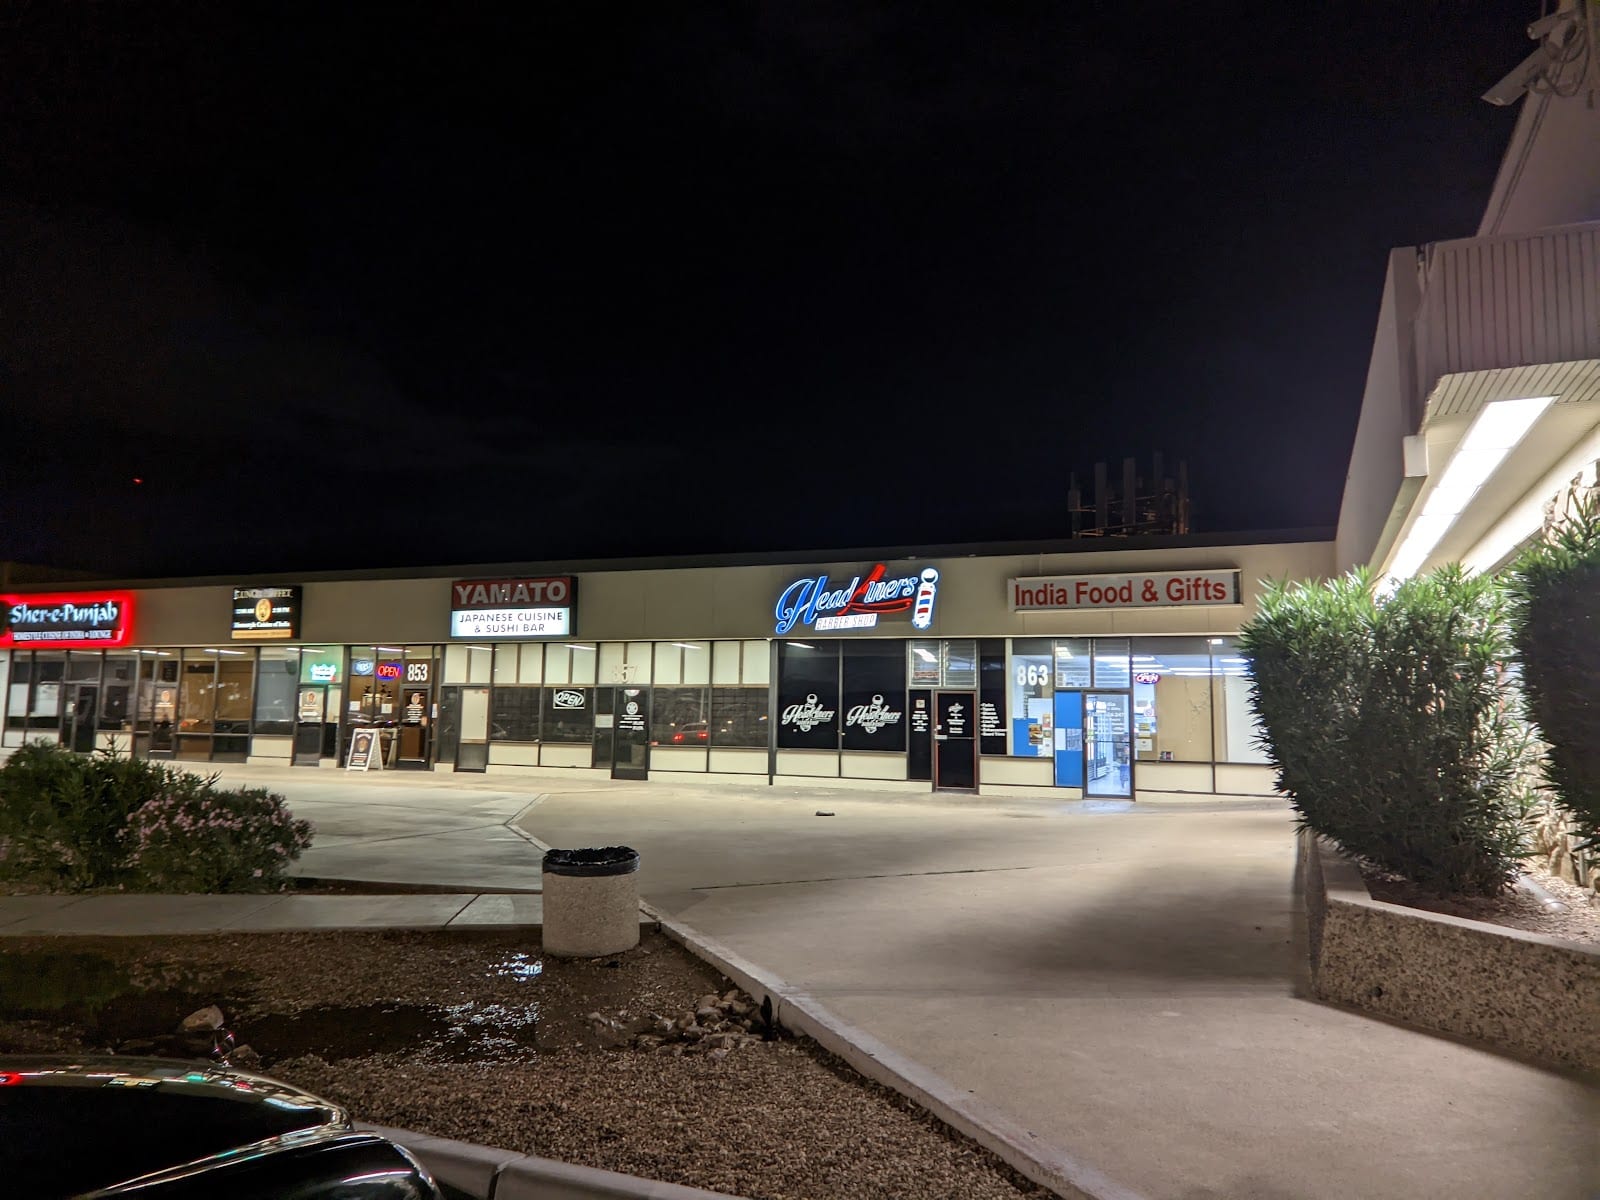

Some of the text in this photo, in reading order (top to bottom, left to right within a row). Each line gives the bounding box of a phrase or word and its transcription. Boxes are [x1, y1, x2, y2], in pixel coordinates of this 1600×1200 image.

[455, 580, 567, 605] YAMATO
[1015, 576, 1227, 606] India Food & Gifts
[9, 600, 119, 627] Sher-e-Punjab
[459, 611, 564, 623] JAPANESE CUISINE
[474, 623, 545, 633] & SUSHI BAR
[816, 614, 876, 630] BARBER SHOP
[378, 666, 400, 677] OPEN
[407, 663, 428, 682] 853
[1017, 664, 1049, 686] 863
[1136, 672, 1160, 684] OPEN
[556, 691, 582, 706] OPEN
